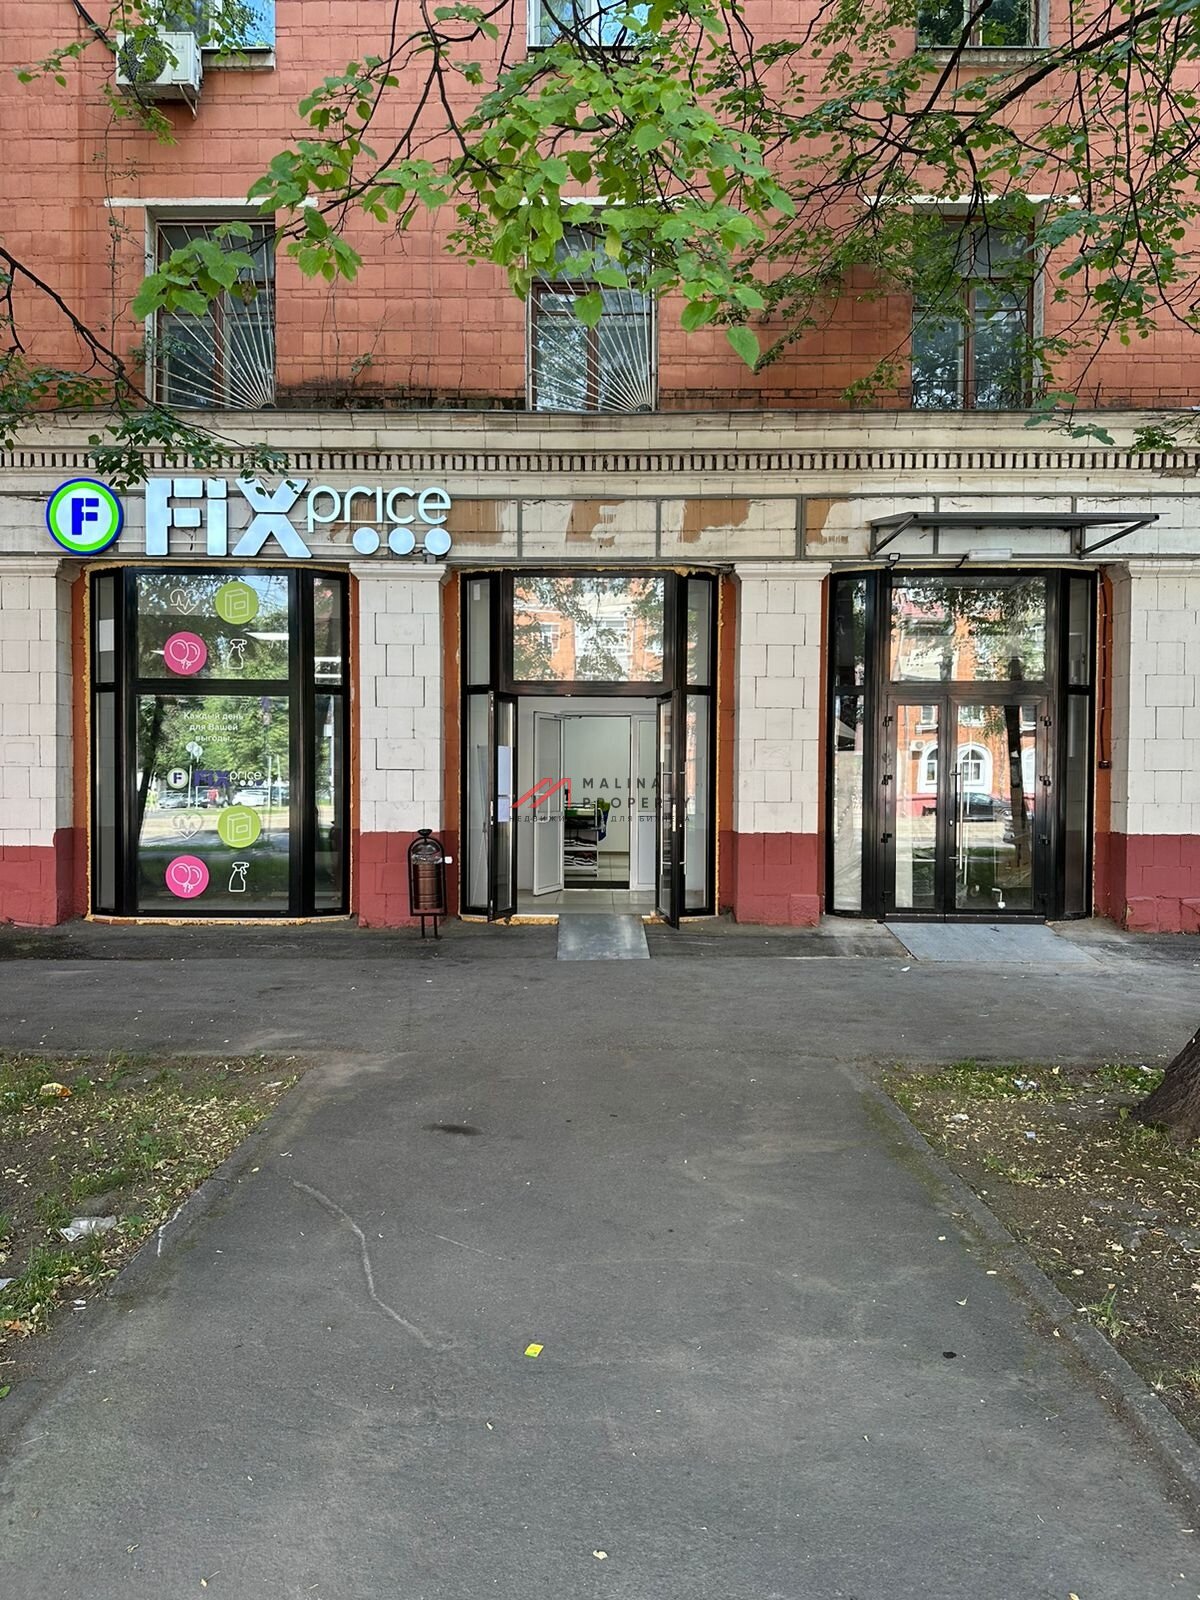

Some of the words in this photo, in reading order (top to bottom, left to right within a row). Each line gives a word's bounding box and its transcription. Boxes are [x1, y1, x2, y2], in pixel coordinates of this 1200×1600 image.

[307, 485, 453, 533] price
[71, 497, 99, 536] F
[183, 712, 220, 721] Каждый
[222, 713, 243, 721] день
[207, 723, 238, 731] Вашей
[229, 770, 262, 782] price
